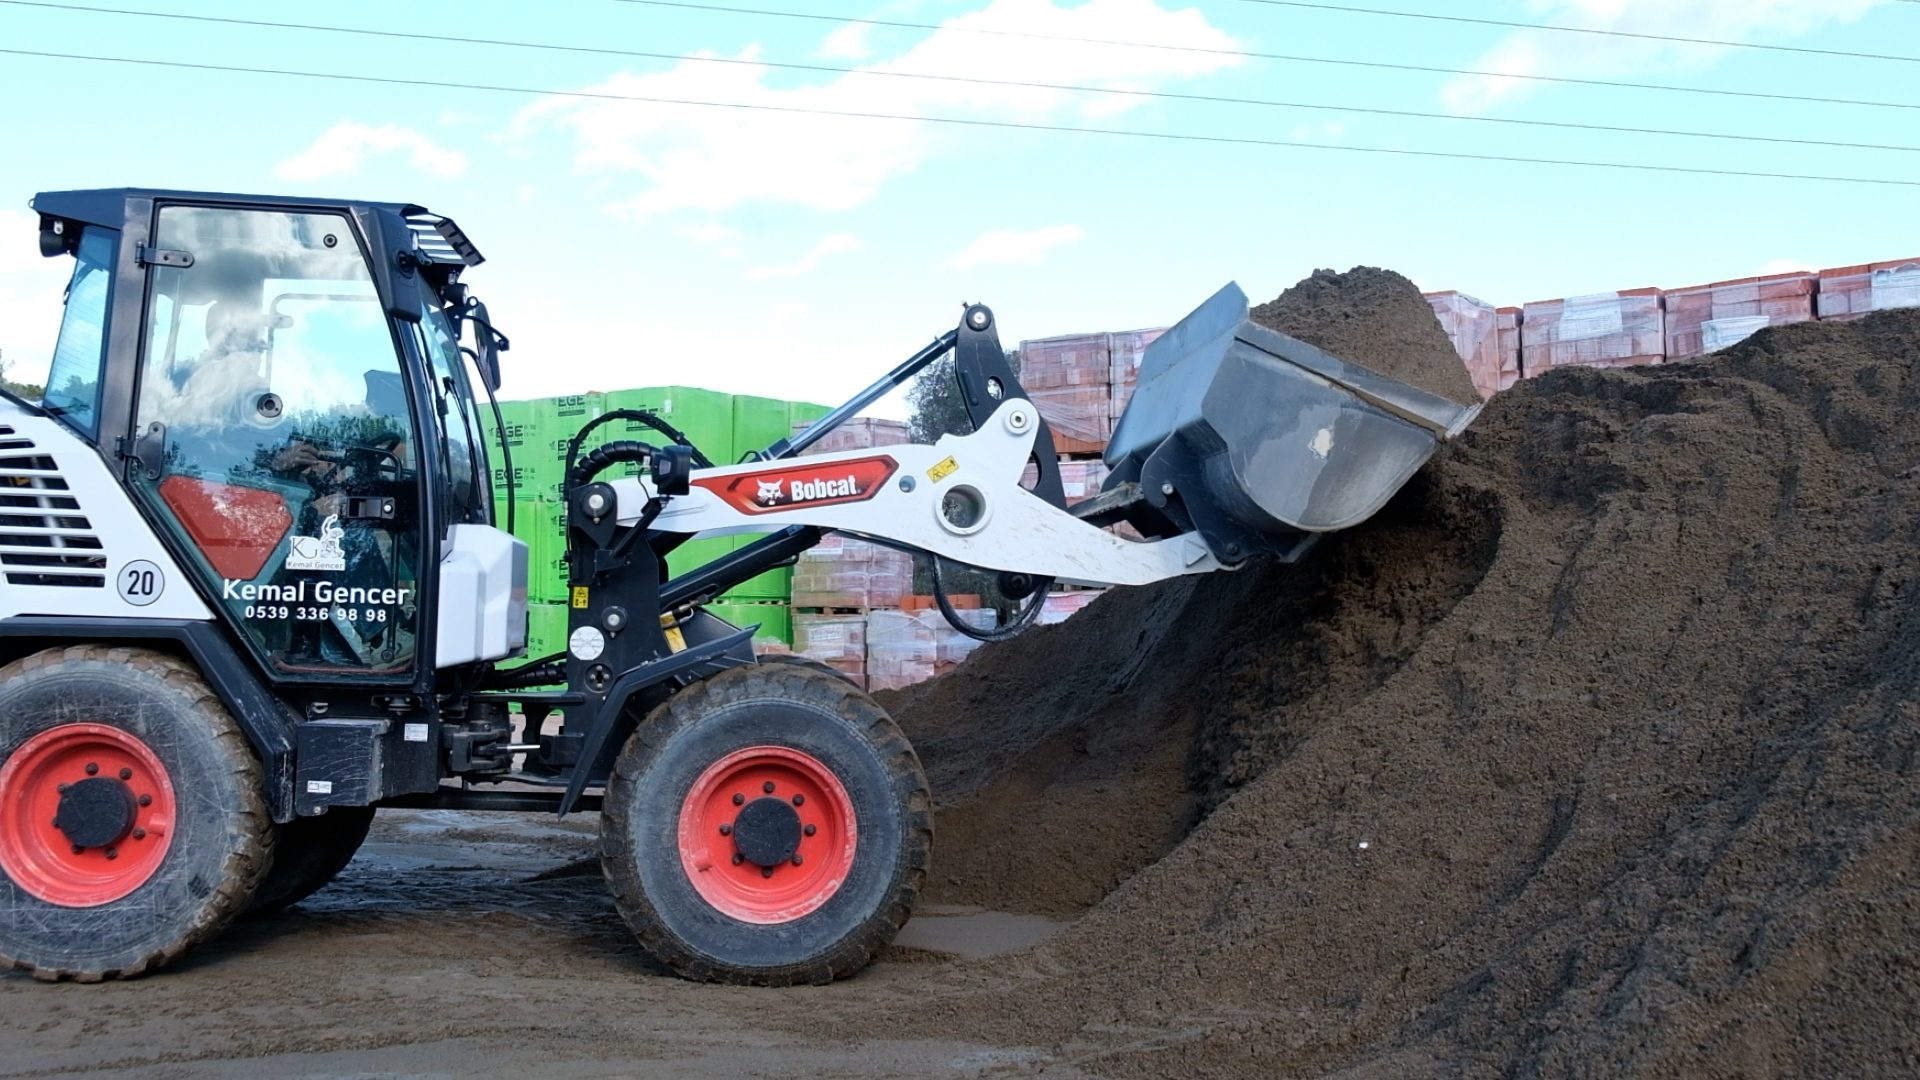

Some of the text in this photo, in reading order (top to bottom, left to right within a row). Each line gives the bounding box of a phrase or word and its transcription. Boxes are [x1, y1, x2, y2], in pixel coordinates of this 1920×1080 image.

[558, 396, 585, 407] EGE
[495, 468, 523, 480] EE
[791, 475, 858, 502] Bobcat
[287, 561, 343, 570] Kemal Gencer
[127, 569, 154, 595] 20
[223, 578, 410, 605] Kemal Gencer
[245, 605, 387, 622] 0539 336 98 98
